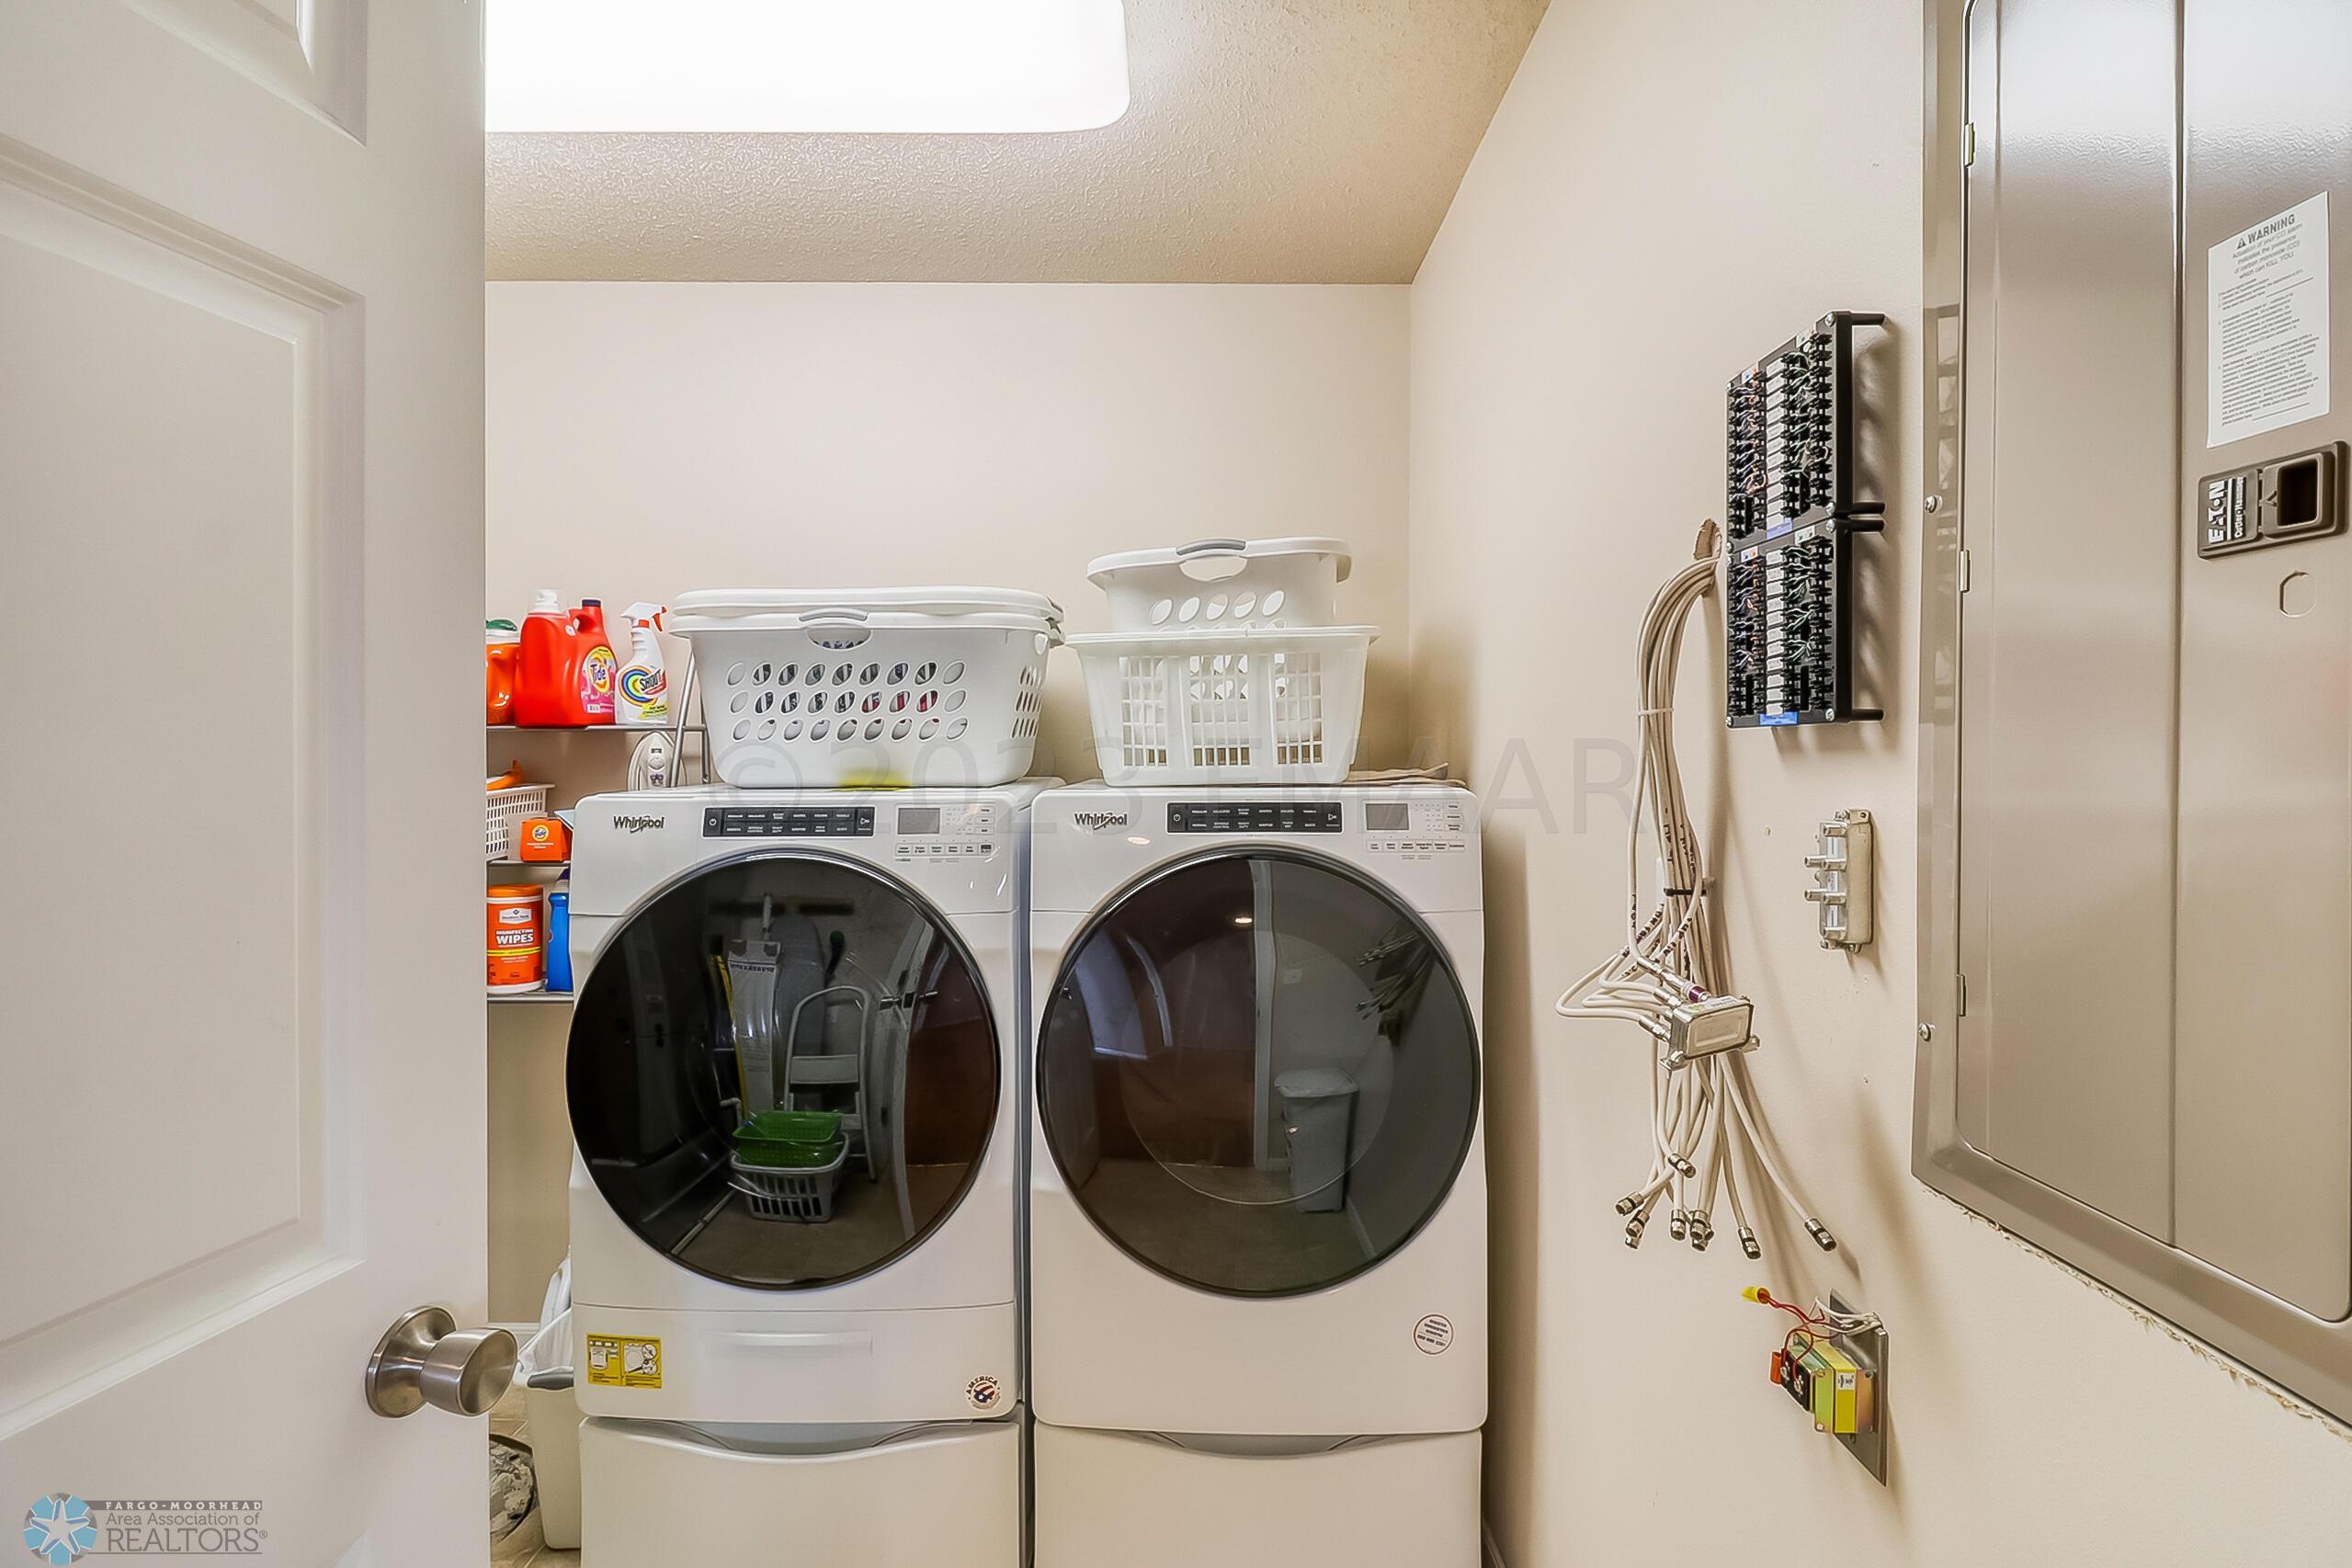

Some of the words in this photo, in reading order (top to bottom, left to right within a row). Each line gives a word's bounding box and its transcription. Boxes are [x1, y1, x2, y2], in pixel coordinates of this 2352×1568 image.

[2247, 213, 2295, 244] WARNING
[2208, 480, 2224, 543] EATON
[590, 664, 606, 684] Tide
[613, 815, 665, 833] Whirlpool
[1074, 812, 1128, 830] Whirlpool
[496, 933, 534, 945] WIPES
[966, 1375, 998, 1395] AMERICA
